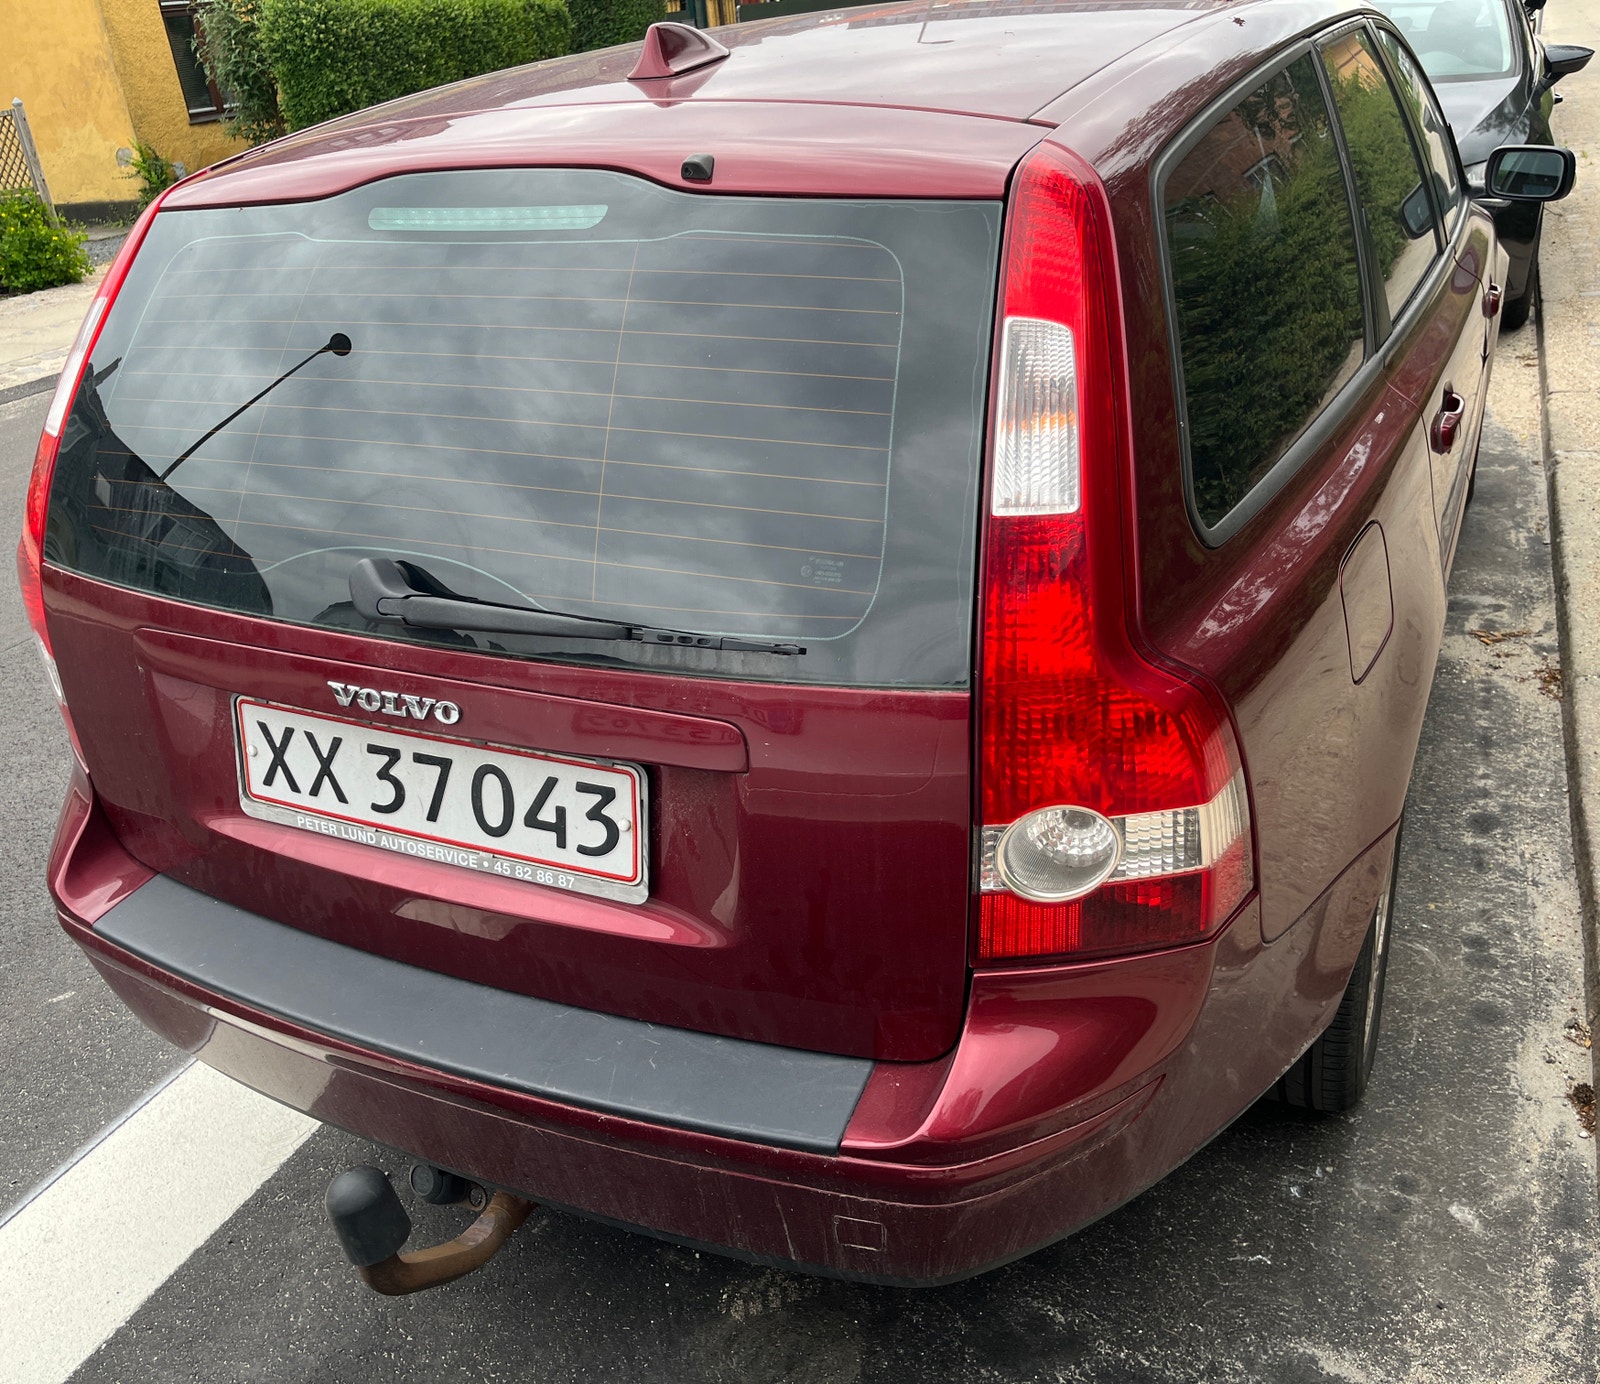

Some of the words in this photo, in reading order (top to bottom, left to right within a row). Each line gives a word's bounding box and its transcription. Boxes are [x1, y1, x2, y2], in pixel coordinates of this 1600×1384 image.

[327, 680, 462, 725] VOLVO
[297, 816, 338, 835] PETER
[341, 826, 376, 844] LUND
[380, 835, 478, 868] AUTOSERVICE
[494, 861, 511, 875] 45
[515, 866, 532, 880] 82
[536, 870, 554, 884] 86
[558, 874, 575, 889] 87
